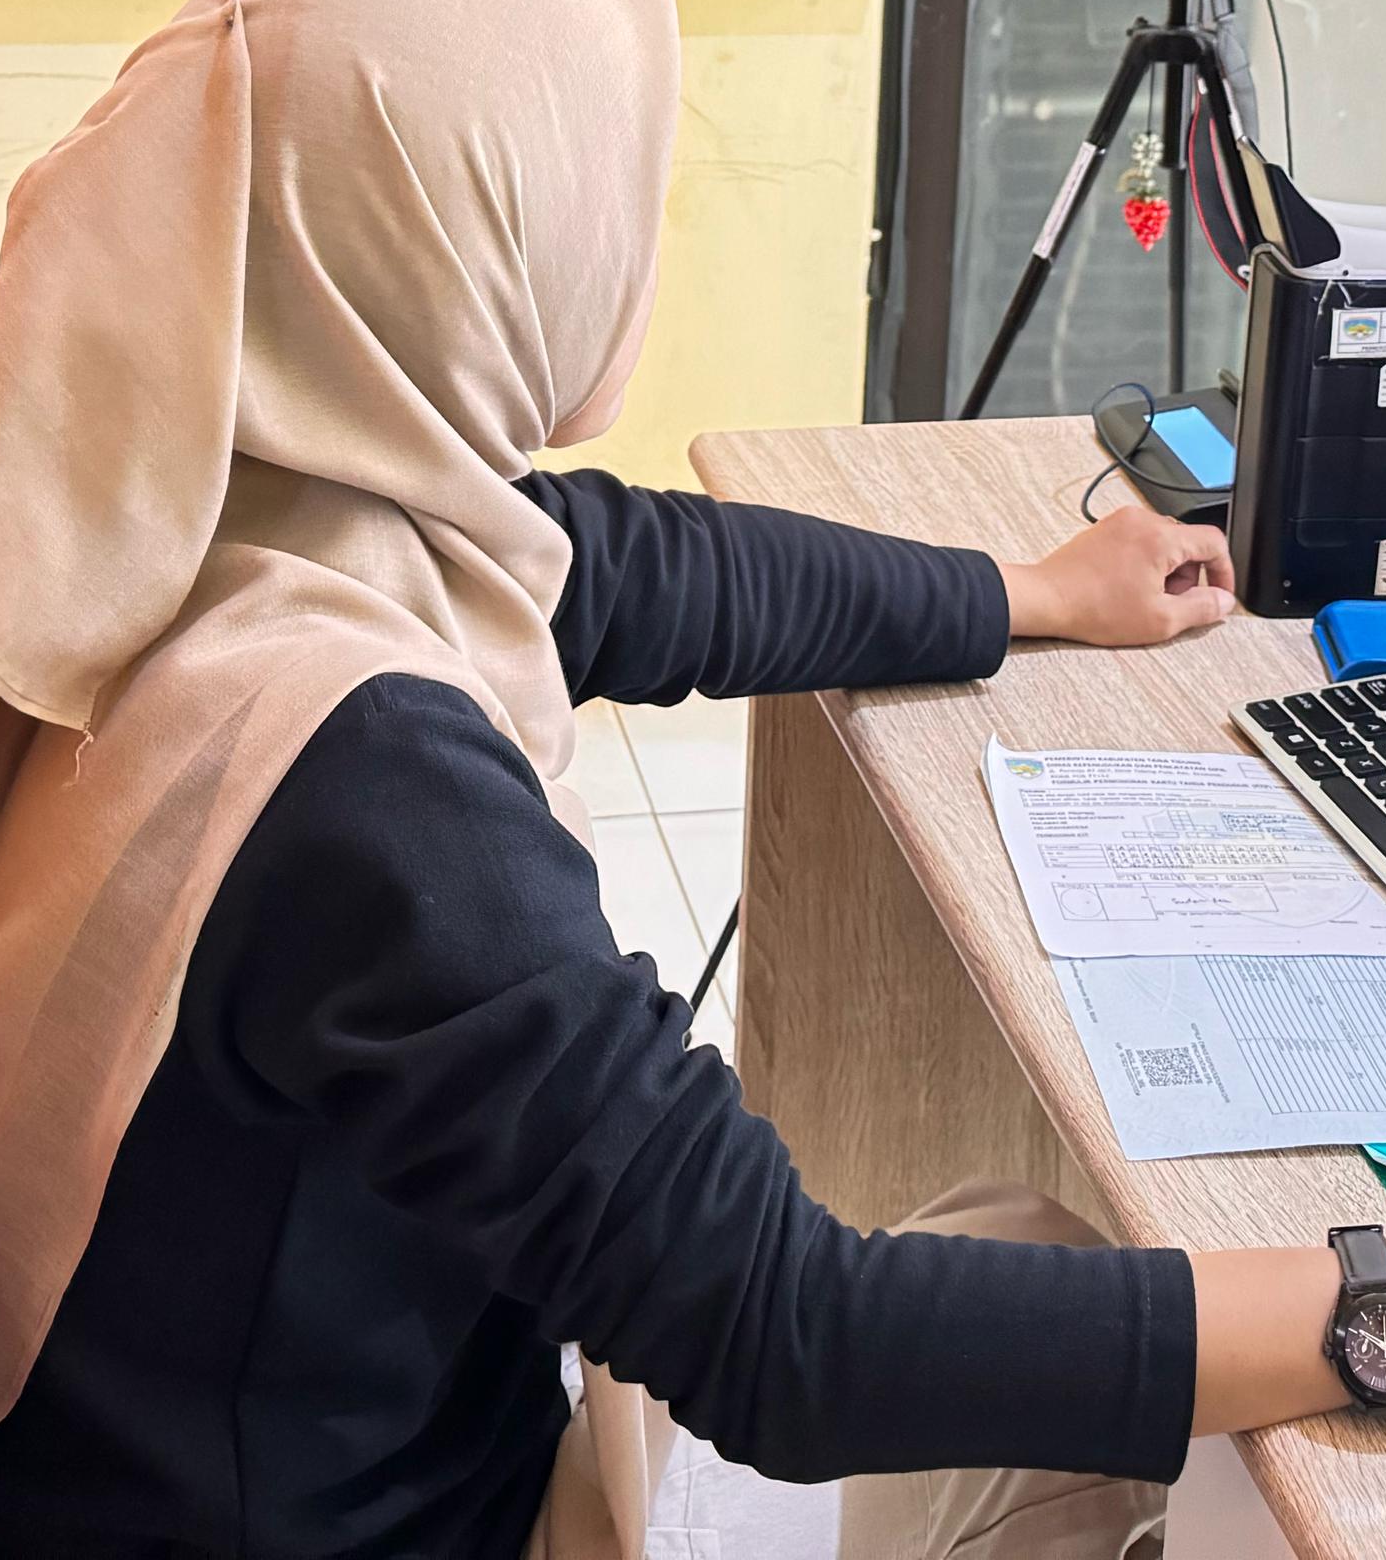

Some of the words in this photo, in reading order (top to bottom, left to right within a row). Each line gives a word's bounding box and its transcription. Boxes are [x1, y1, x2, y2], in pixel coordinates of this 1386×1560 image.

[1367, 723, 1381, 731] A
[1339, 740, 1354, 748] Z
[1359, 759, 1374, 767] X
